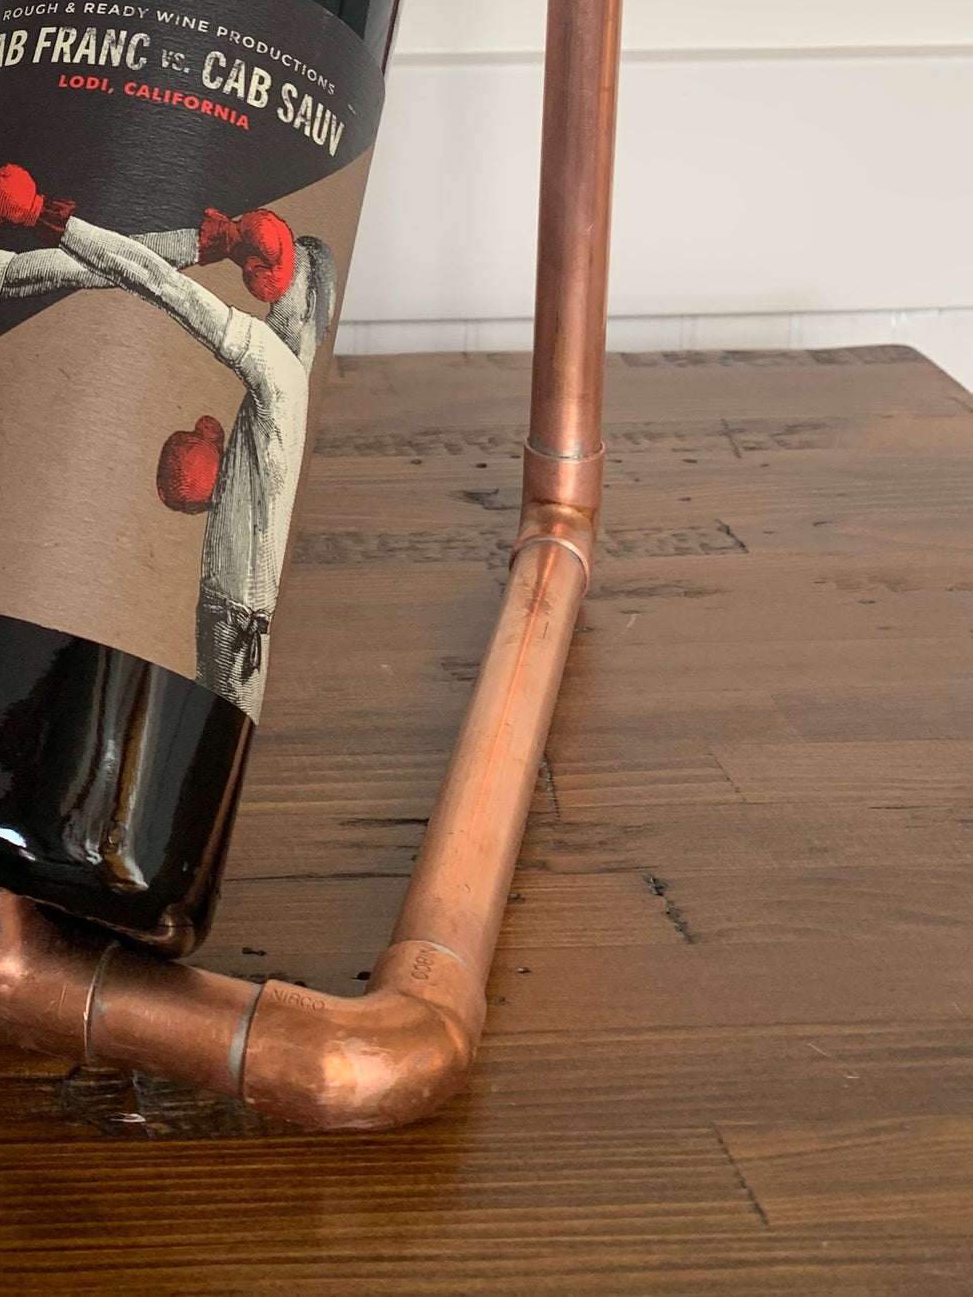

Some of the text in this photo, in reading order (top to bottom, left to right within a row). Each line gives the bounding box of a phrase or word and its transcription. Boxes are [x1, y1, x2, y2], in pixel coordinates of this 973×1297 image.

[2, 2, 335, 96] ROUGH & READY WINE PRODUCTIONS
[32, 26, 152, 71] FRANC
[201, 50, 273, 109] CAB
[277, 82, 345, 157] SAUV
[58, 74, 250, 131] LODI, CALIFORNIA
